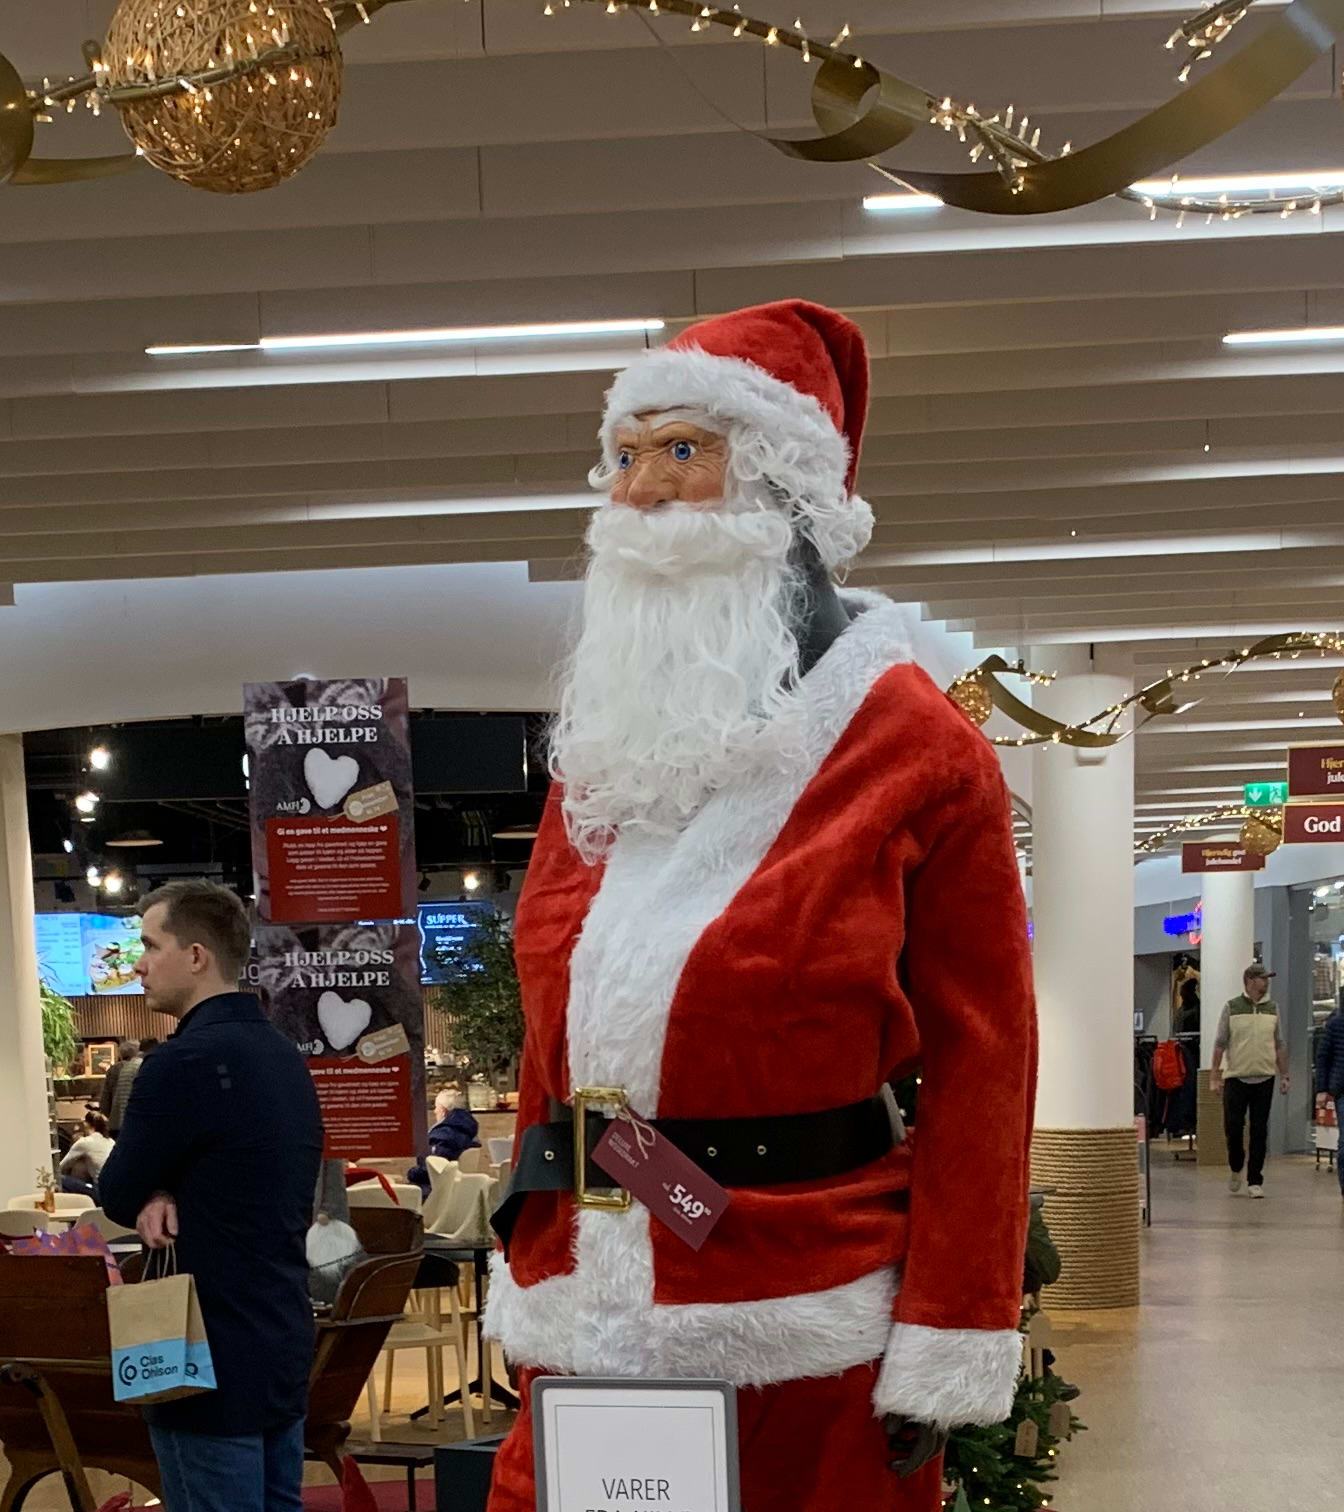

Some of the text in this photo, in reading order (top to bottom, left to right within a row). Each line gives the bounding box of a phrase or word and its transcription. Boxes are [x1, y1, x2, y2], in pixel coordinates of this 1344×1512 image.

[270, 704, 382, 723] HJELP OSS
[297, 727, 378, 744] HJELPE
[1304, 816, 1341, 833] God
[284, 949, 394, 967] HJELP OSS
[310, 971, 390, 987] HJELPE
[669, 1184, 705, 1219] 549
[140, 1355, 165, 1367] Clas
[141, 1365, 179, 1380] Ohlson
[602, 1478, 670, 1501] VARER
